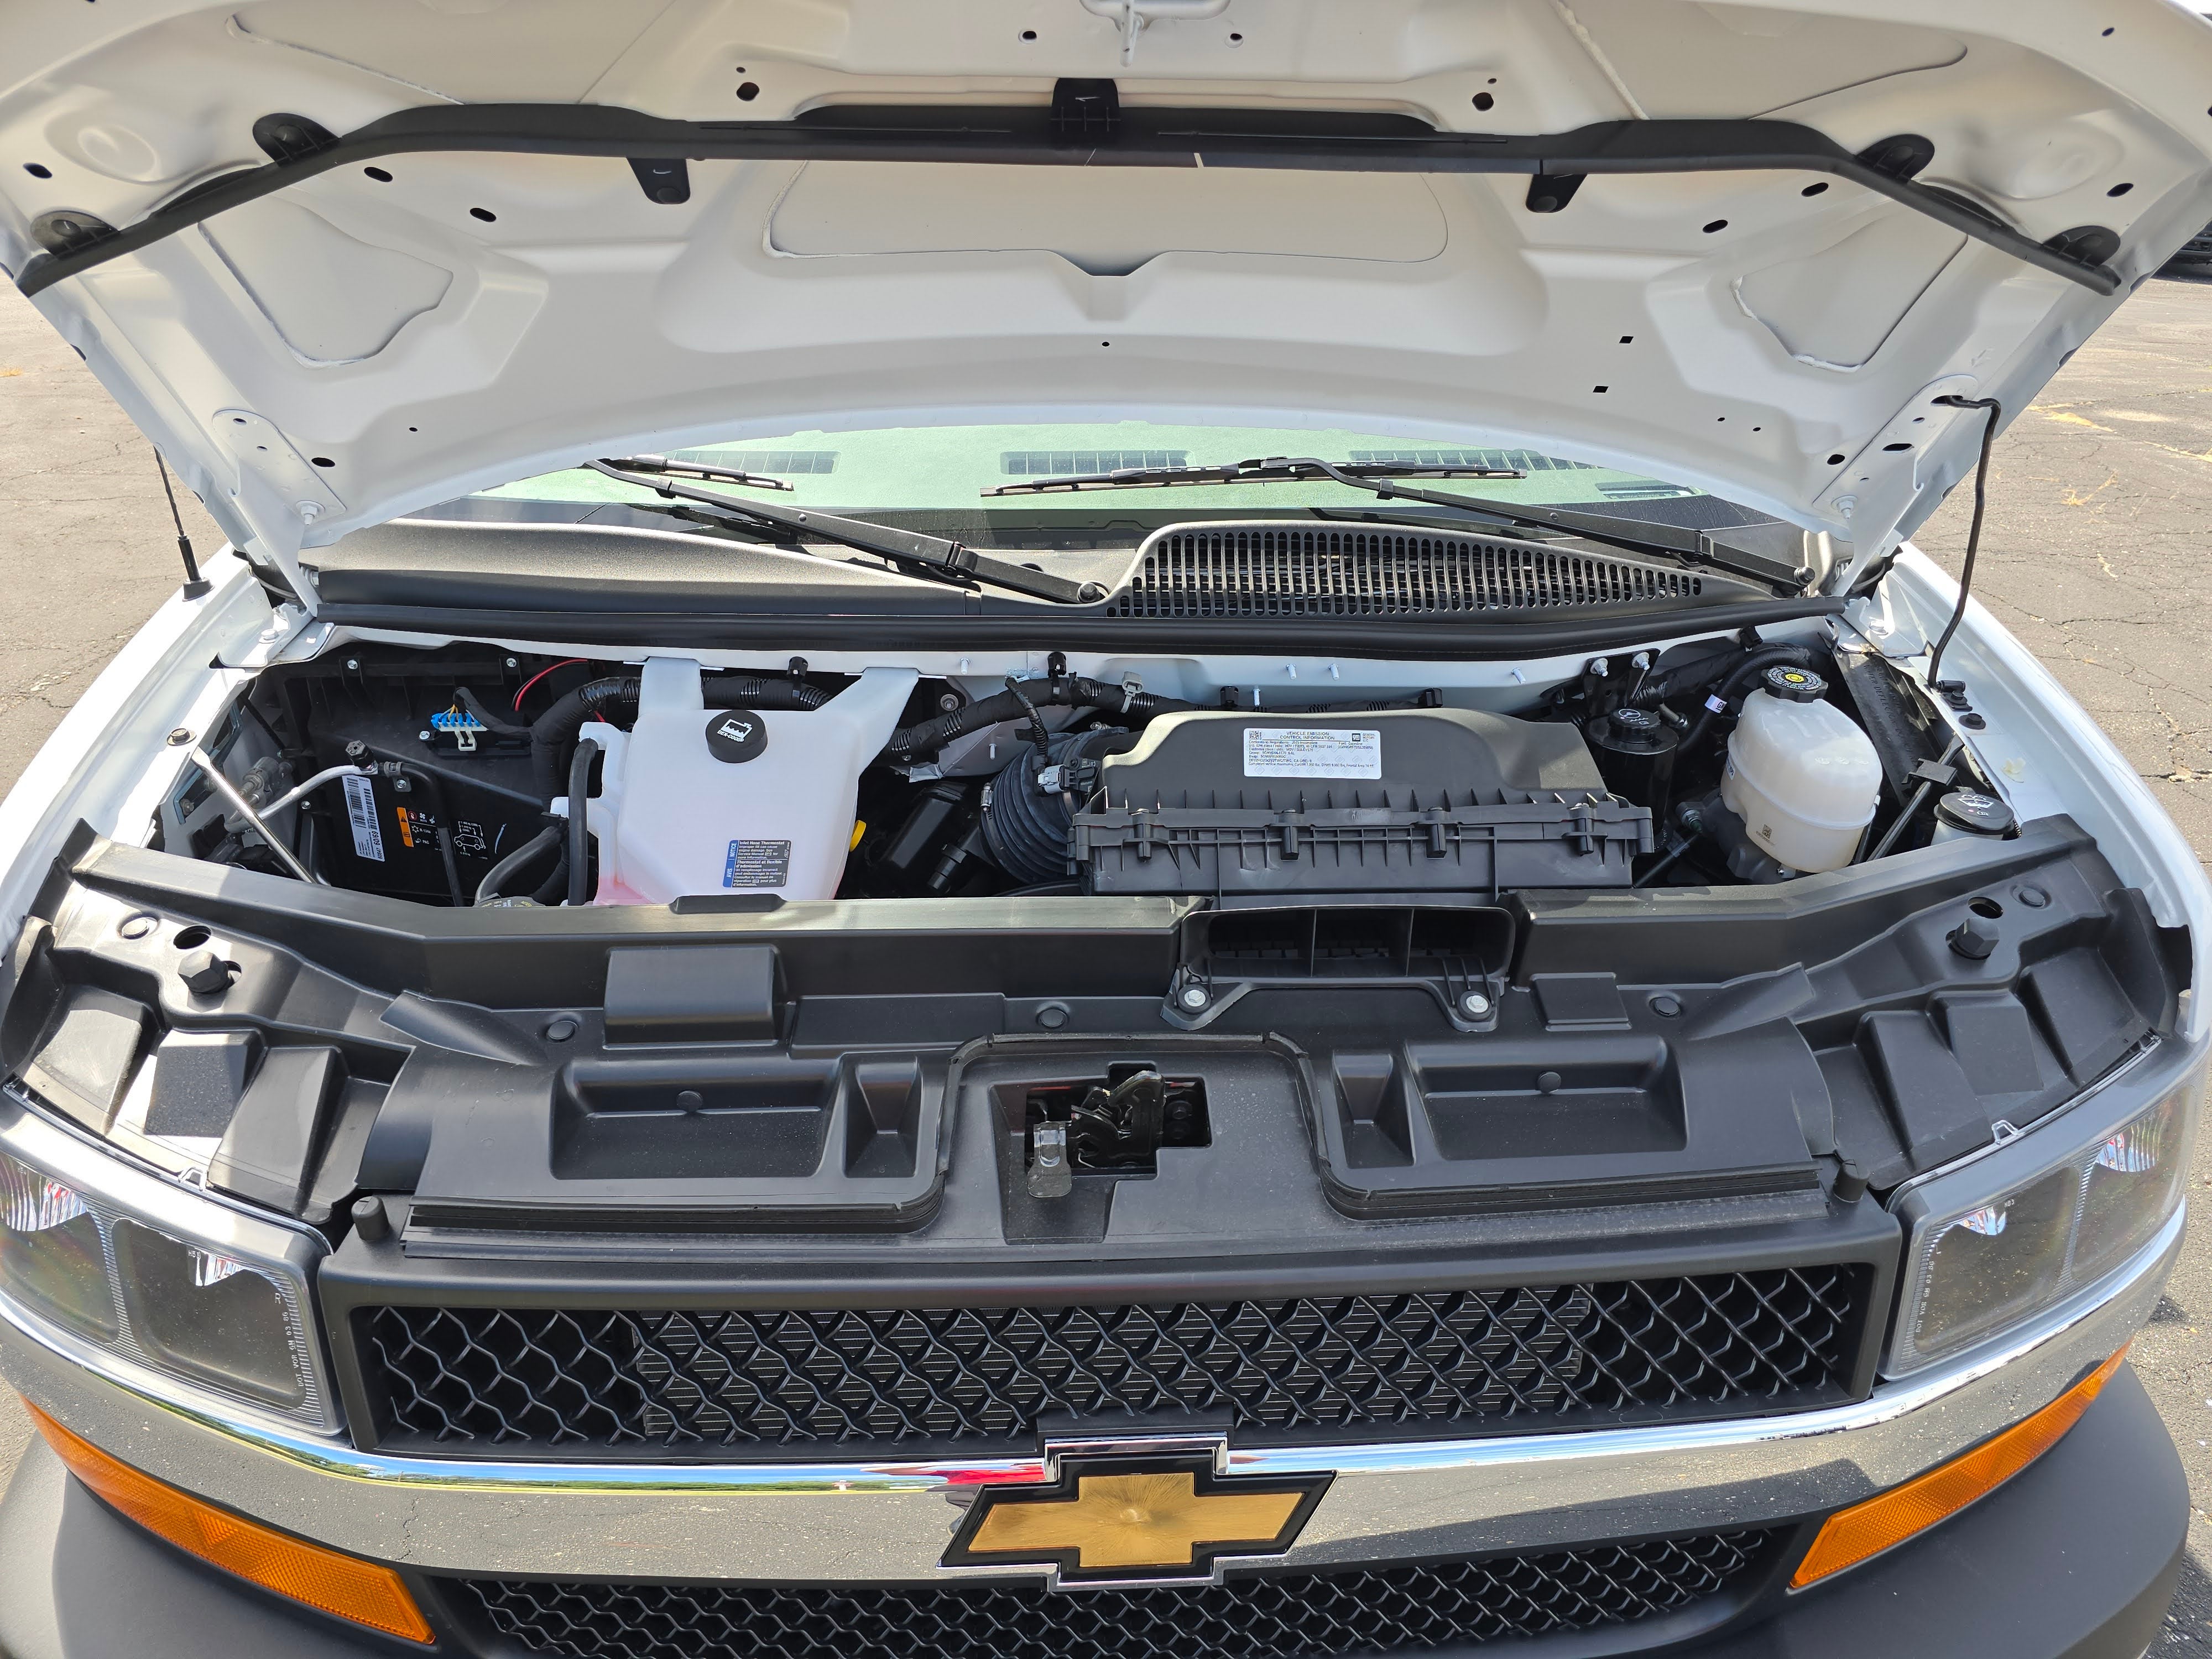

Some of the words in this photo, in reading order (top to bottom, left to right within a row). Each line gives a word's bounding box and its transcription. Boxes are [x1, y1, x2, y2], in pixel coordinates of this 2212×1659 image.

[372, 831, 380, 846] 60/69
[1926, 1274, 1932, 1284] 03
[275, 1292, 281, 1305] R
[1923, 1287, 1931, 1298] GM
[1919, 1301, 1927, 1315] VOR
[285, 1326, 292, 1335] 03
[288, 1340, 296, 1350] GM
[291, 1354, 299, 1369] VOR
[295, 1373, 304, 1387] DOT
